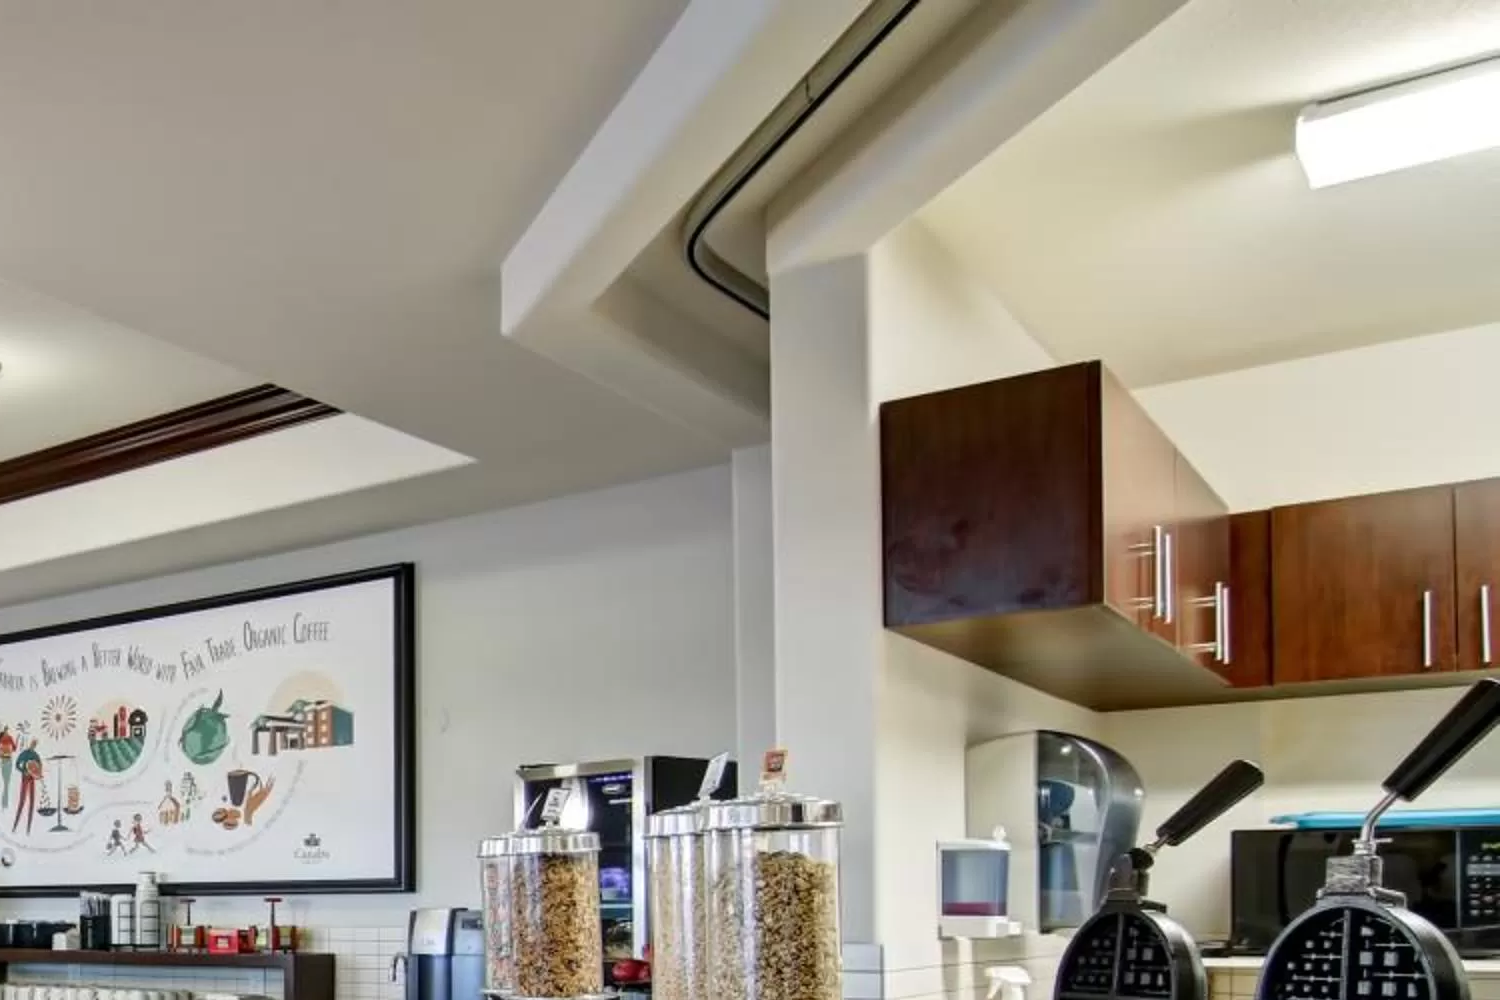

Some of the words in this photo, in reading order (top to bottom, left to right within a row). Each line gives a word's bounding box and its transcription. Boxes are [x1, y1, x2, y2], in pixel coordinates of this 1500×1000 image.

[81, 655, 88, 672] A
[92, 641, 121, 669] BETTER
[180, 649, 205, 680] FAIR
[243, 621, 287, 651] ORGANIC
[293, 612, 331, 643] COFFEE
